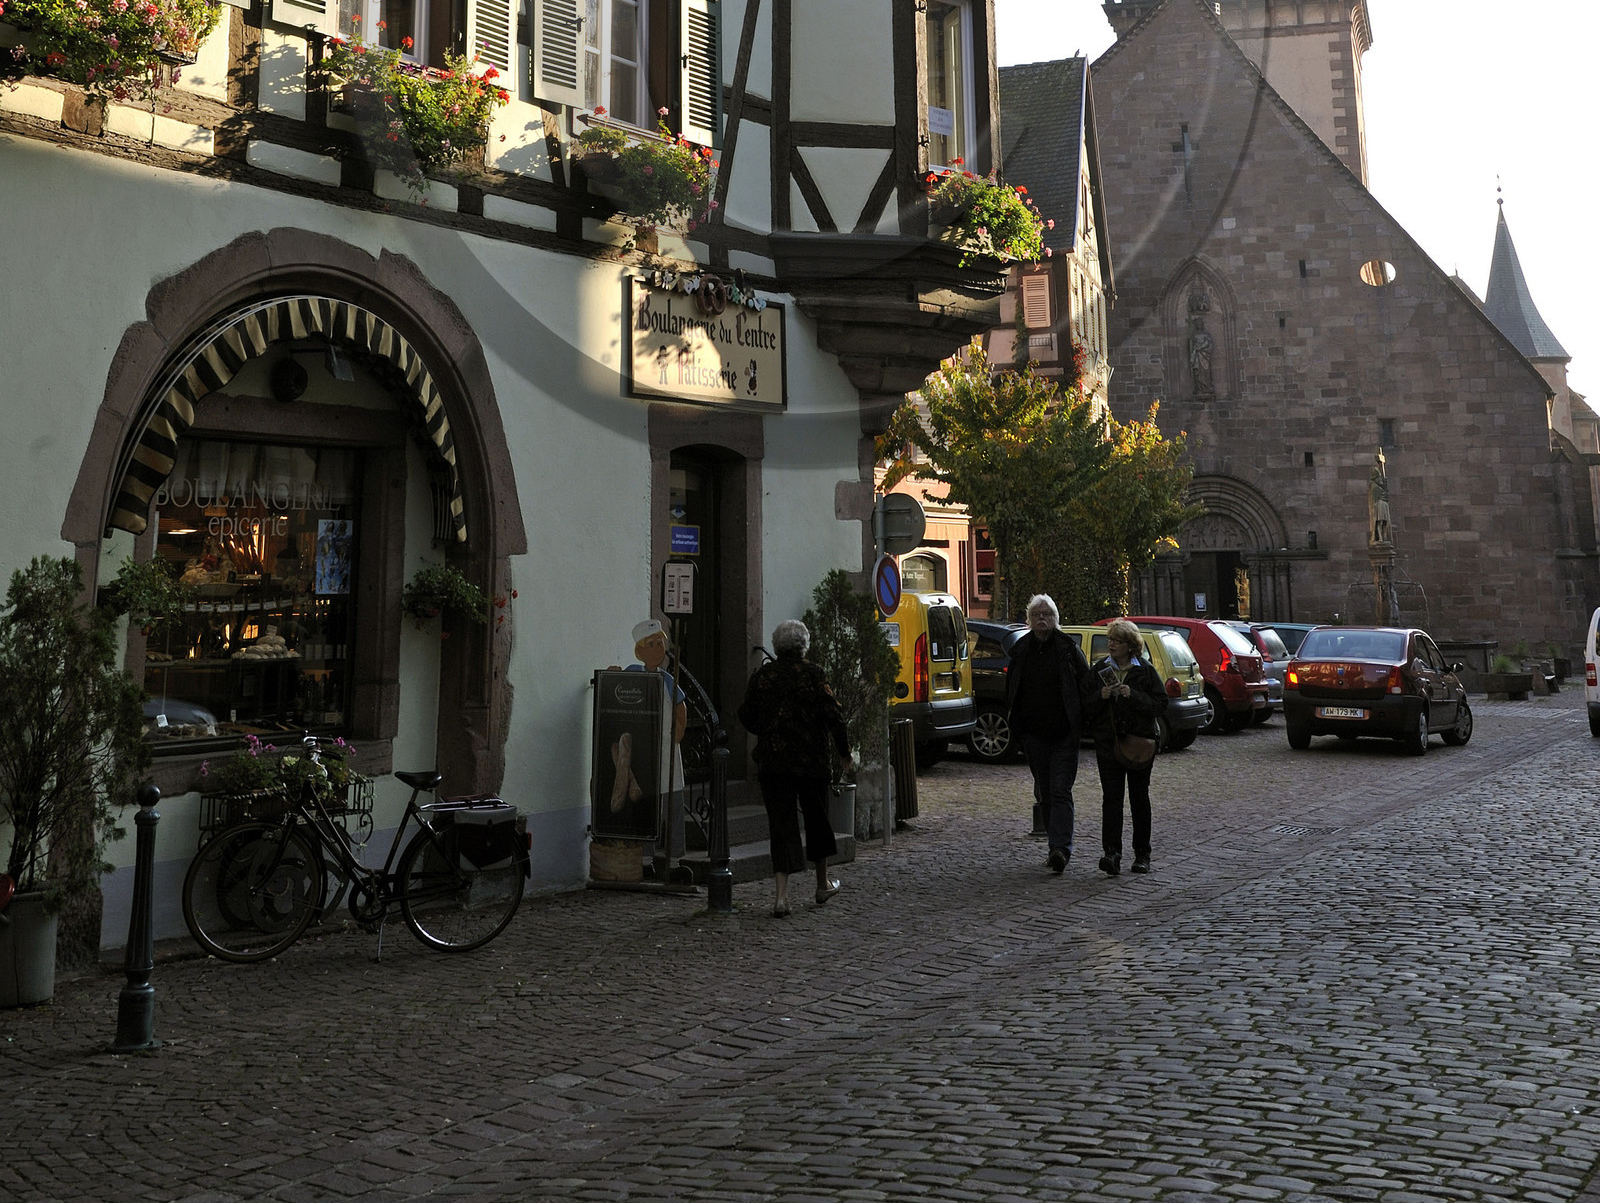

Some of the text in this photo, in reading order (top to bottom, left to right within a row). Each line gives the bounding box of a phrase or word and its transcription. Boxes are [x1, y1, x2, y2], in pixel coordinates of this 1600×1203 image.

[638, 293, 777, 350] Boulangerie du Centre
